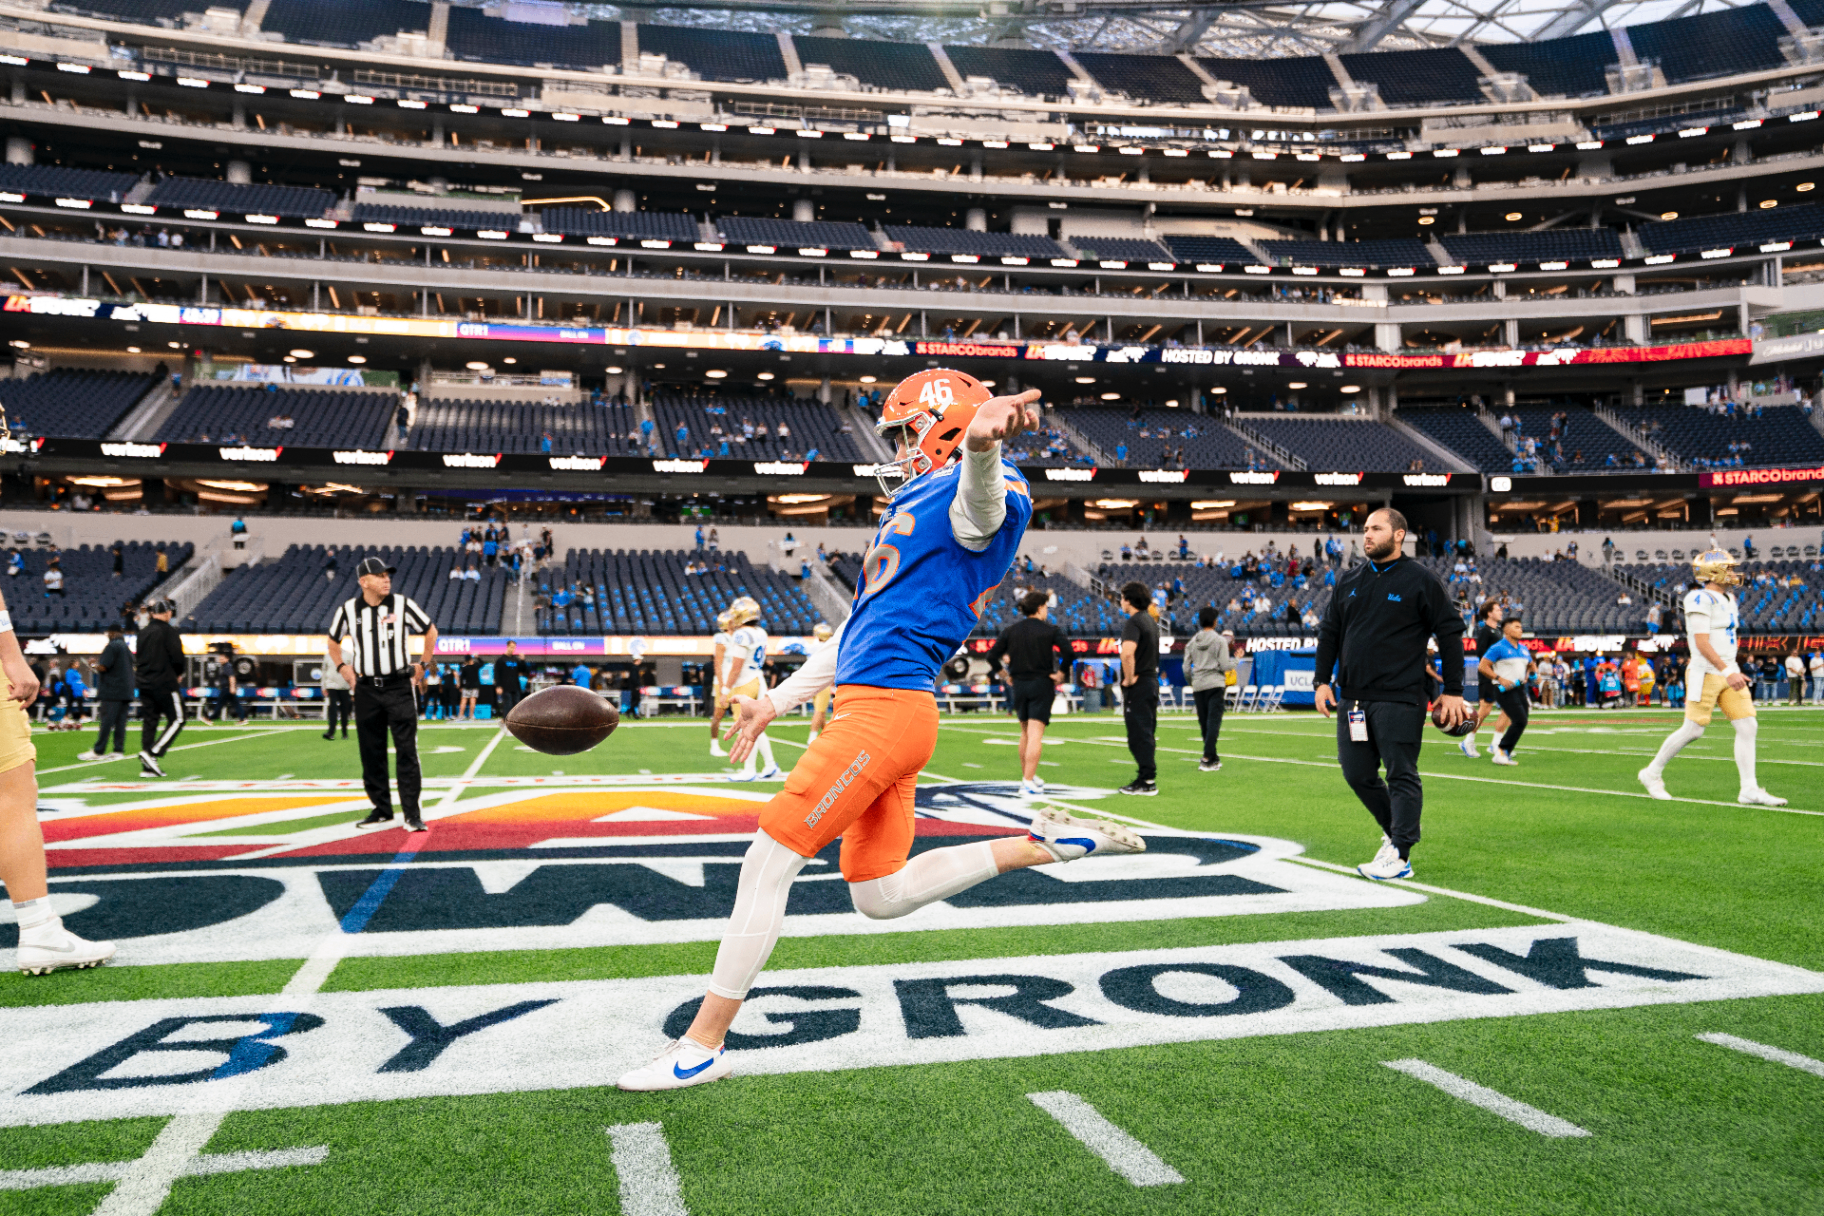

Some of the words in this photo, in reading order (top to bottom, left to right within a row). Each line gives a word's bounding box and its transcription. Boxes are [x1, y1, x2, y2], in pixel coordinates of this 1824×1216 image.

[1161, 349, 1213, 364] HOSTED
[1213, 351, 1233, 365] BY
[1233, 352, 1281, 366] GRONK
[918, 378, 954, 407] 46
[856, 512, 916, 595] 6
[437, 638, 471, 652] QTR1
[1290, 676, 1313, 687] UCL
[803, 749, 871, 829] BRONCOS
[16, 998, 564, 1096] BY
[662, 936, 1712, 1052] GRONK
